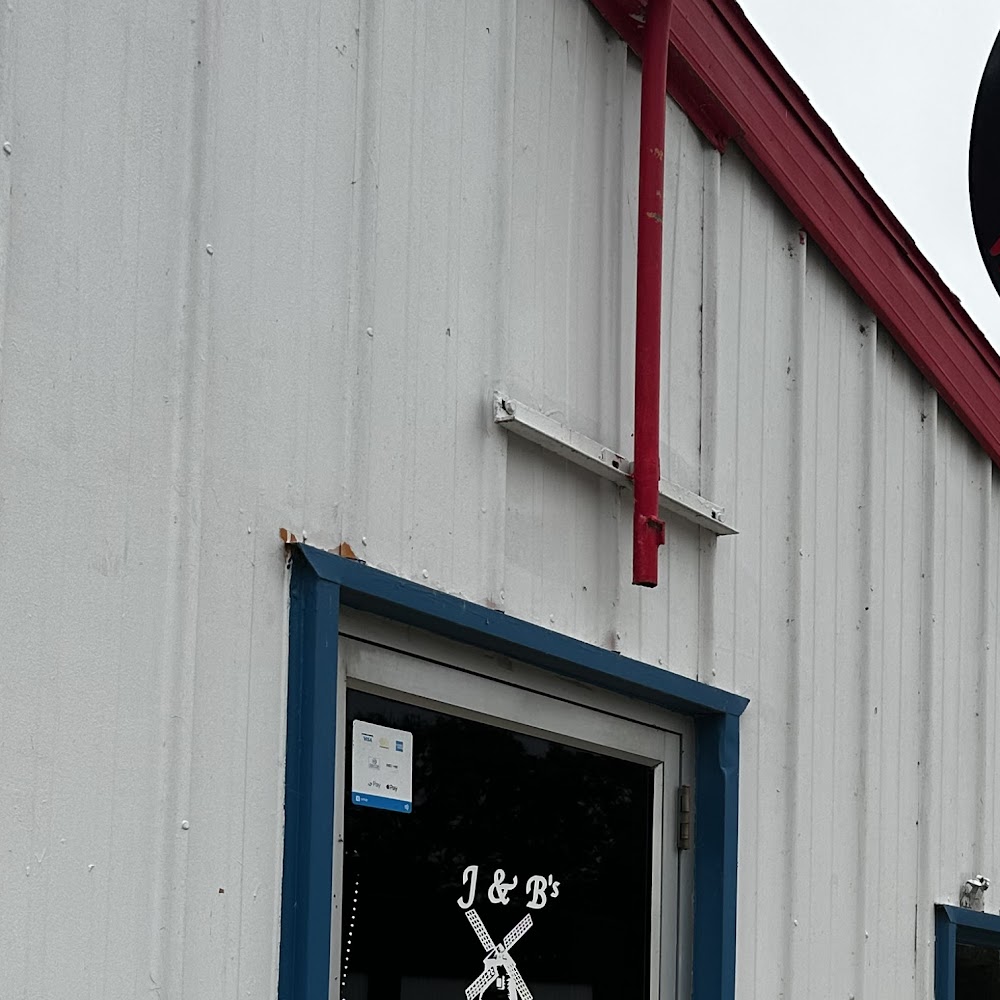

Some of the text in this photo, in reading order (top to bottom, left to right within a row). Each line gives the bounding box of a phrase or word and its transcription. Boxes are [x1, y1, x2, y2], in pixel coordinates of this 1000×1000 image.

[457, 865, 561, 910] J & B's
